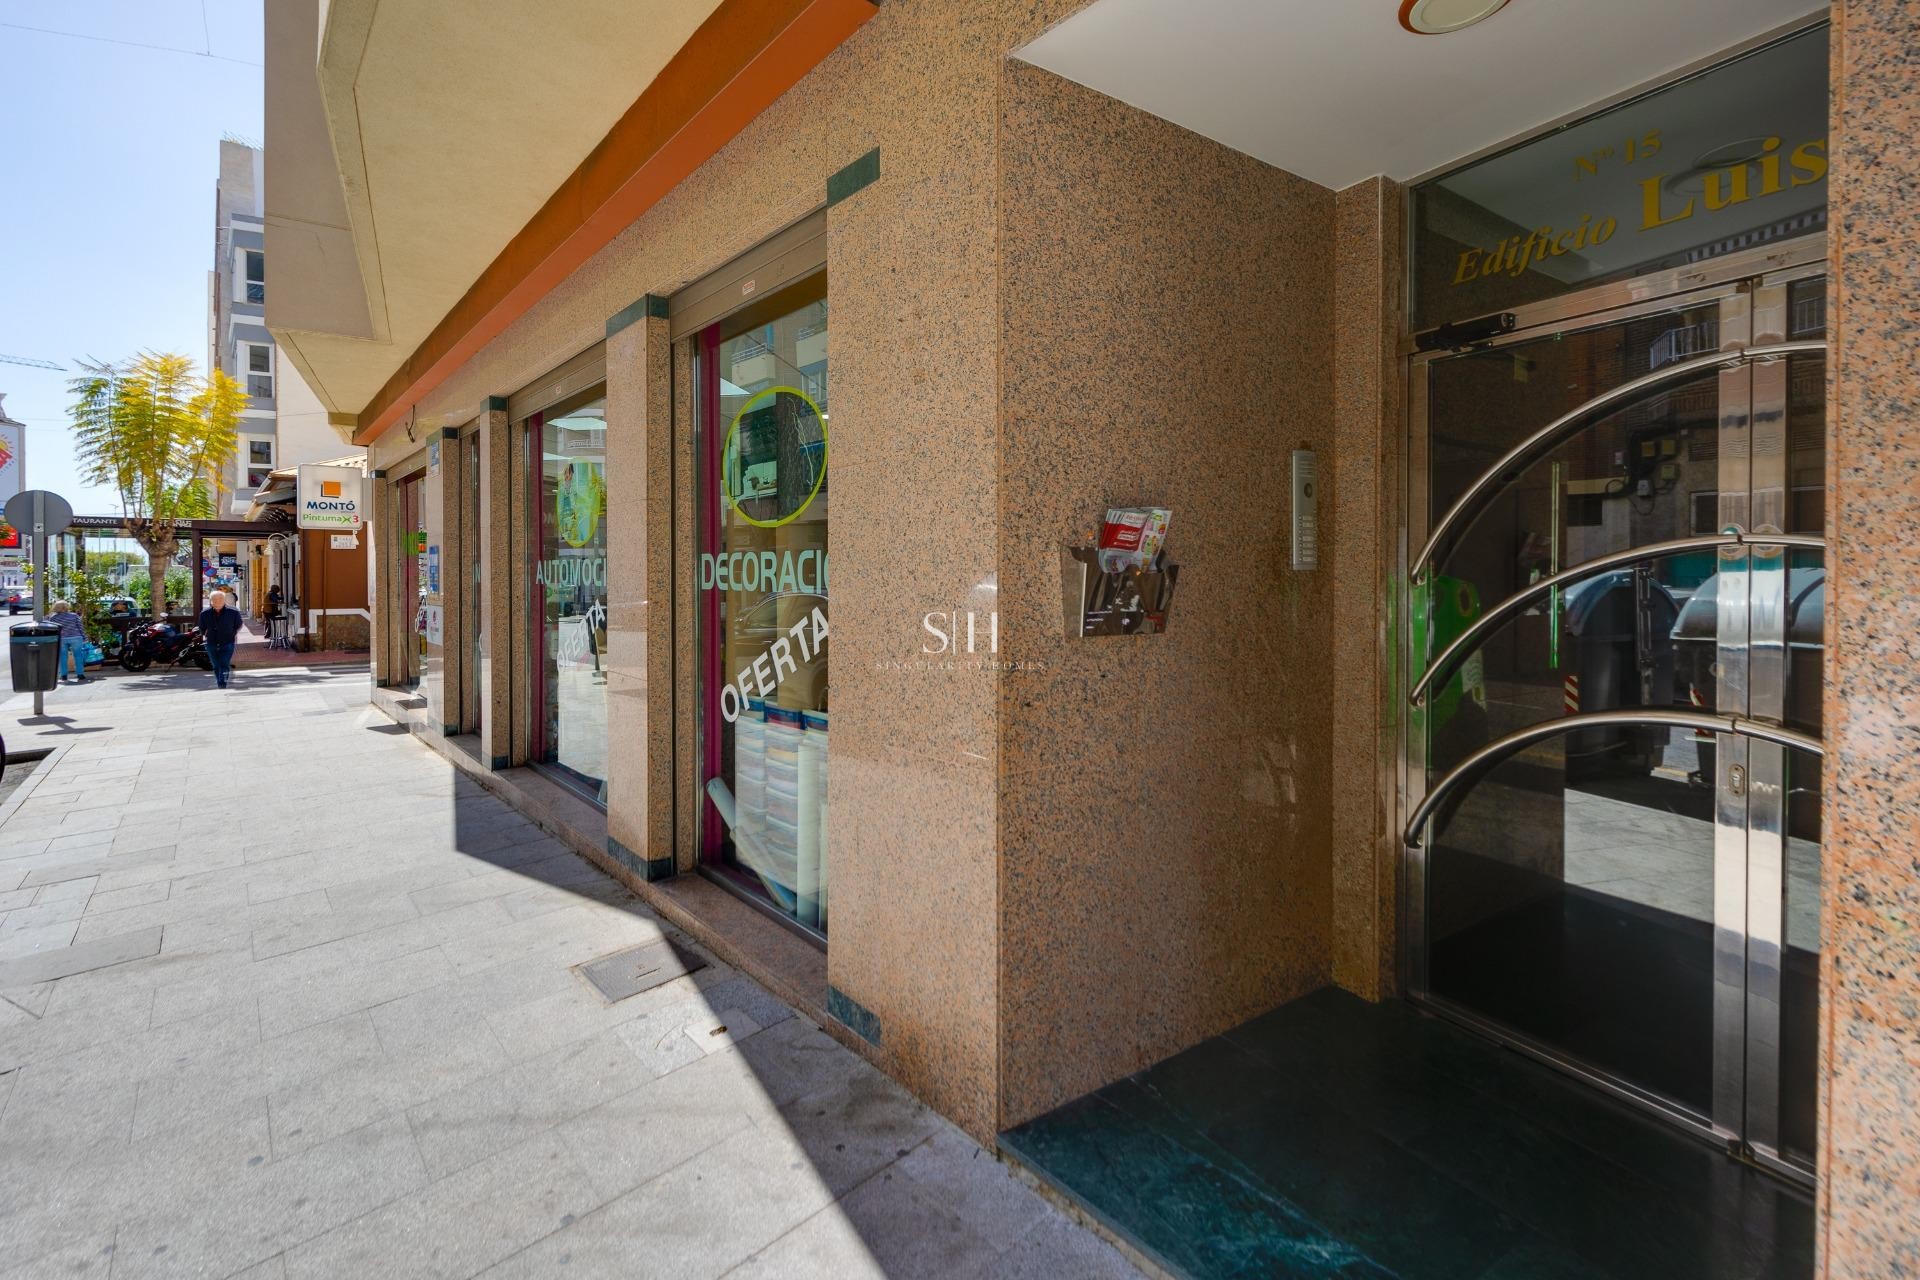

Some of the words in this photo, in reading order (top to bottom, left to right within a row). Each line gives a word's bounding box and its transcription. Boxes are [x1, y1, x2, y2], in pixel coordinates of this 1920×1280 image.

[1624, 128, 1662, 166] 15
[1452, 213, 1617, 286] Edificio
[1638, 136, 1828, 232] Luis
[307, 500, 355, 510] MONTÓ
[720, 606, 829, 723] OFERTA
